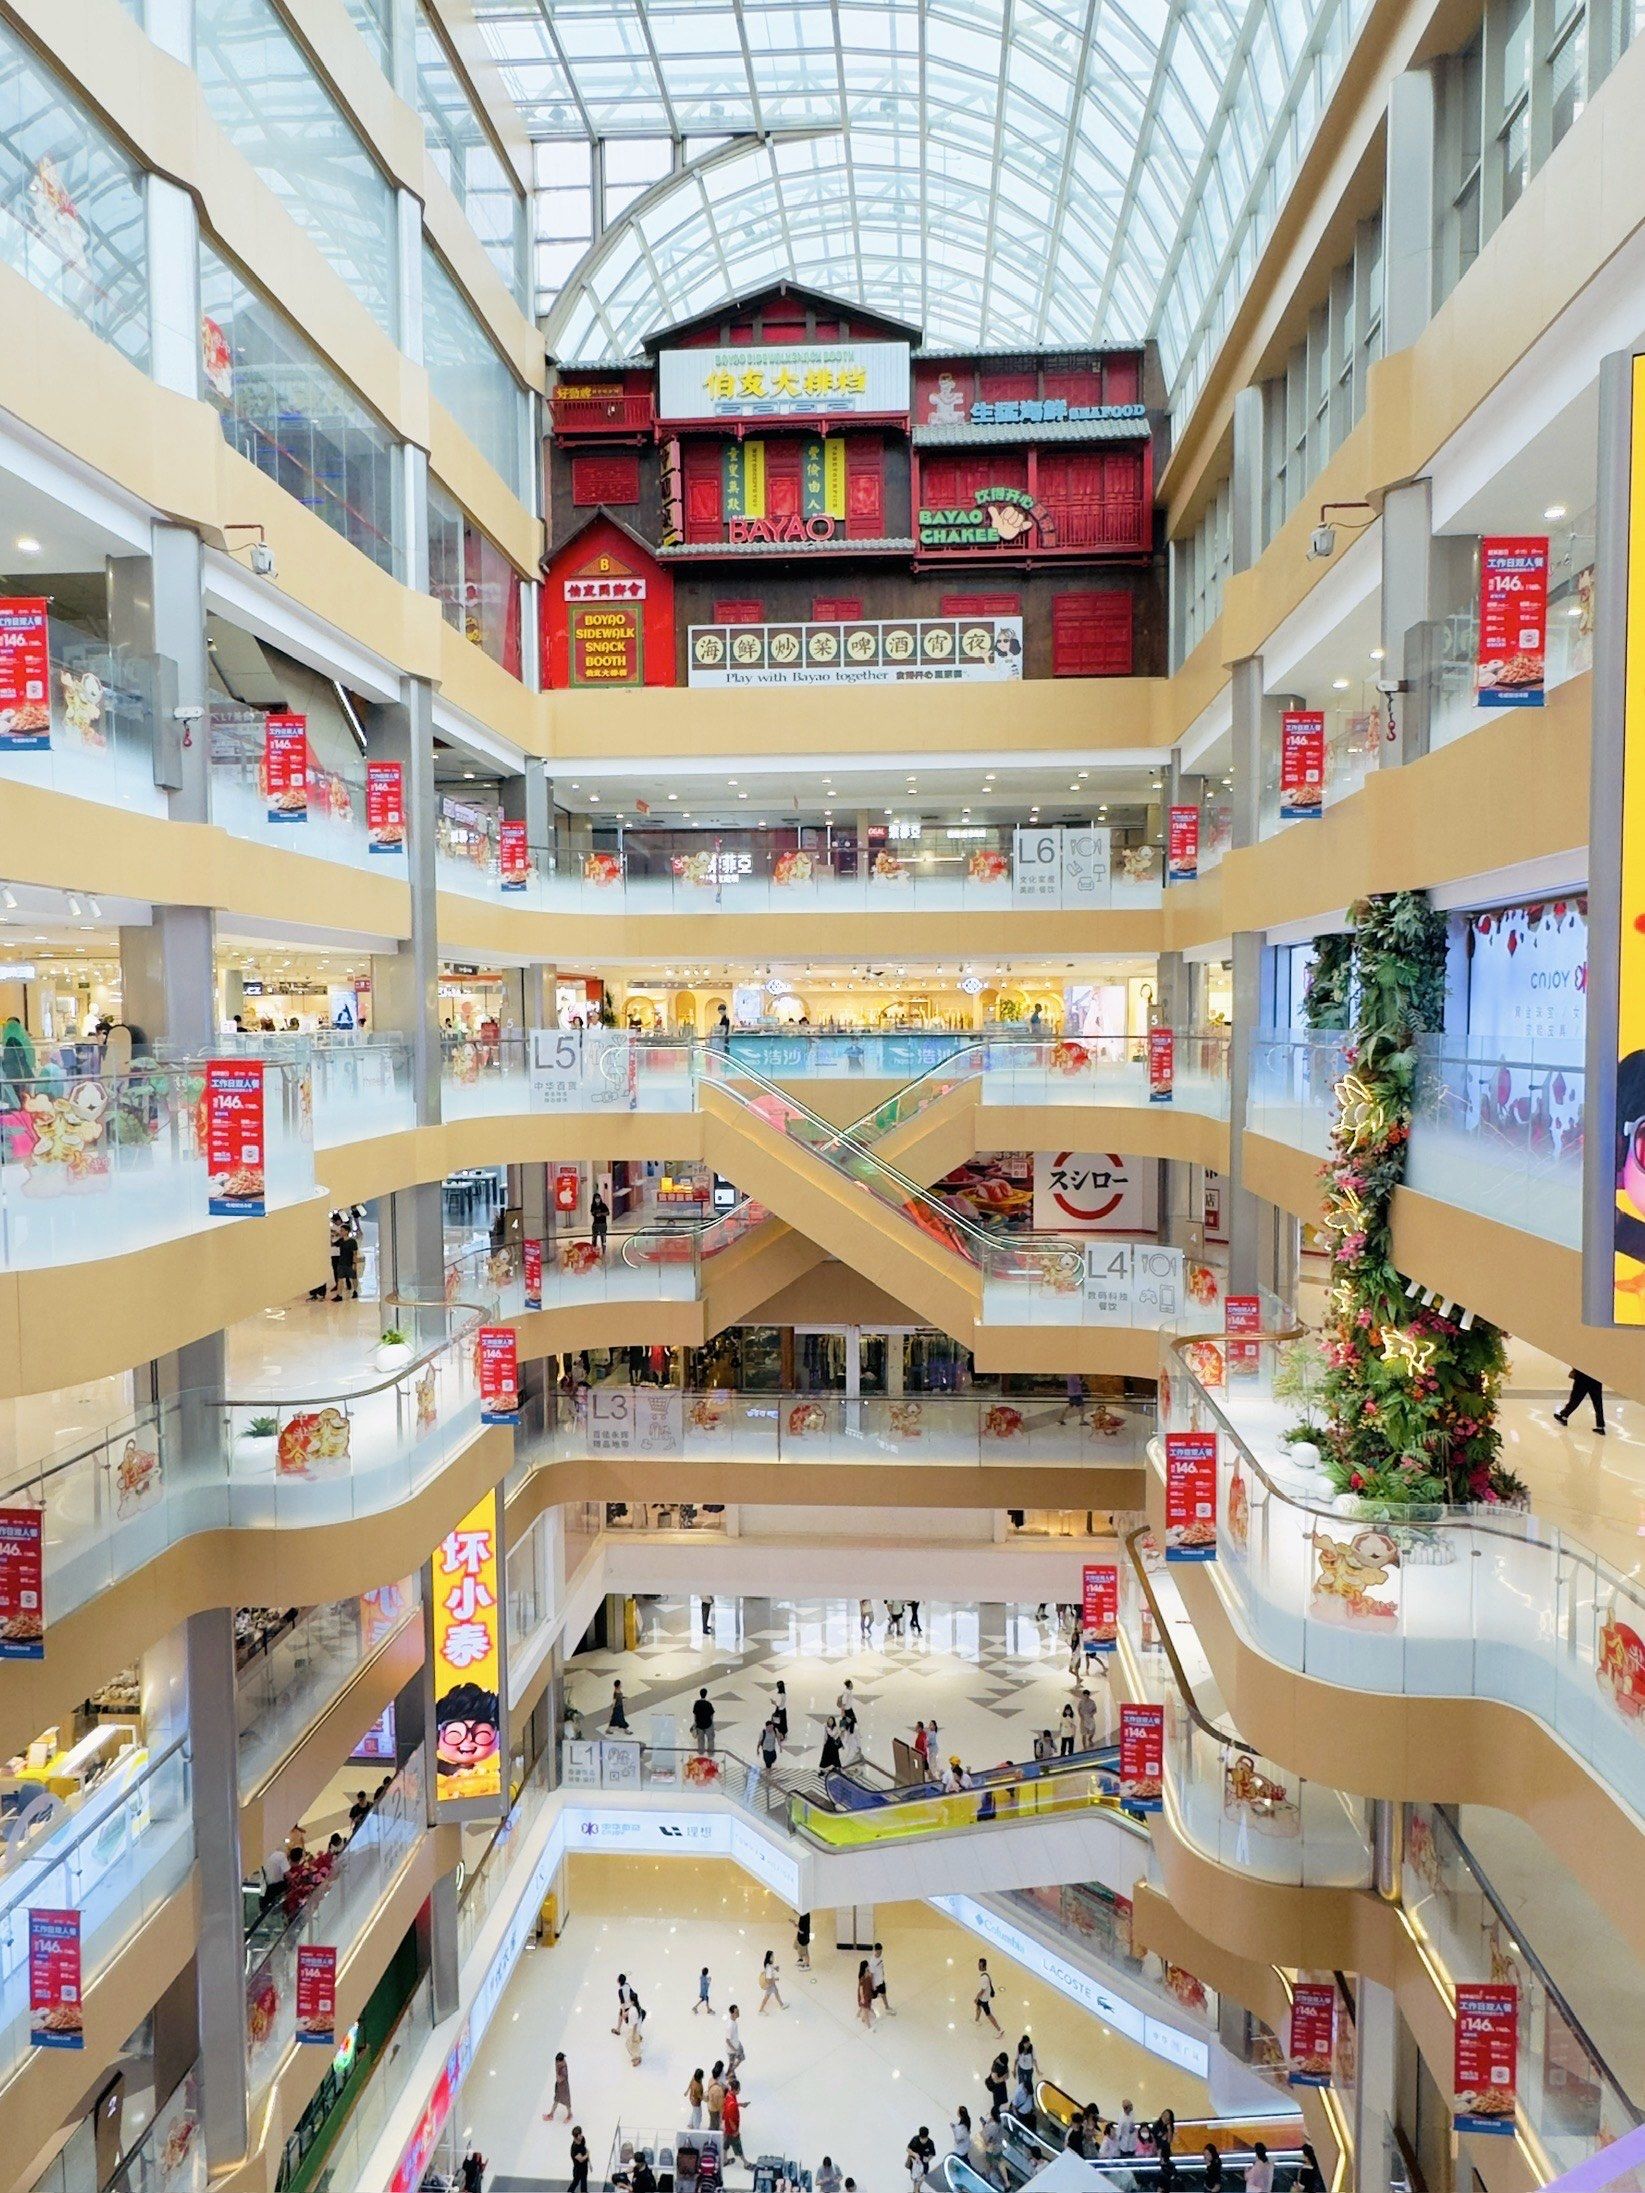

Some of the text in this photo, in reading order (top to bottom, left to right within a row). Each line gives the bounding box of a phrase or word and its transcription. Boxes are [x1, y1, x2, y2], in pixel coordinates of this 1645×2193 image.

[918, 508, 984, 526] BAYAO
[729, 514, 836, 543] BAYAO
[920, 528, 1000, 544] CHAKEE
[600, 558, 610, 571] B
[1495, 575, 1521, 591] 146
[584, 614, 626, 626] BOYAO
[575, 628, 635, 640] SIDEWALK
[585, 641, 626, 653] SNACK
[585, 655, 627, 667] BOOTH
[726, 670, 889, 684] Play with Bayao together
[1019, 837, 1056, 864] L6
[1151, 1014, 1158, 1025] 5
[534, 1036, 576, 1069] L5
[763, 1048, 802, 1065] 浩沙
[218, 1095, 242, 1109] 146
[1048, 1169, 1129, 1190] スシロー
[1088, 1250, 1128, 1280] L4
[593, 1394, 628, 1420] L3
[1175, 1461, 1197, 1474] 146
[570, 1745, 593, 1765] L1
[1040, 1958, 1093, 1999] LACOSTE
[1466, 2017, 1492, 2032] 146
